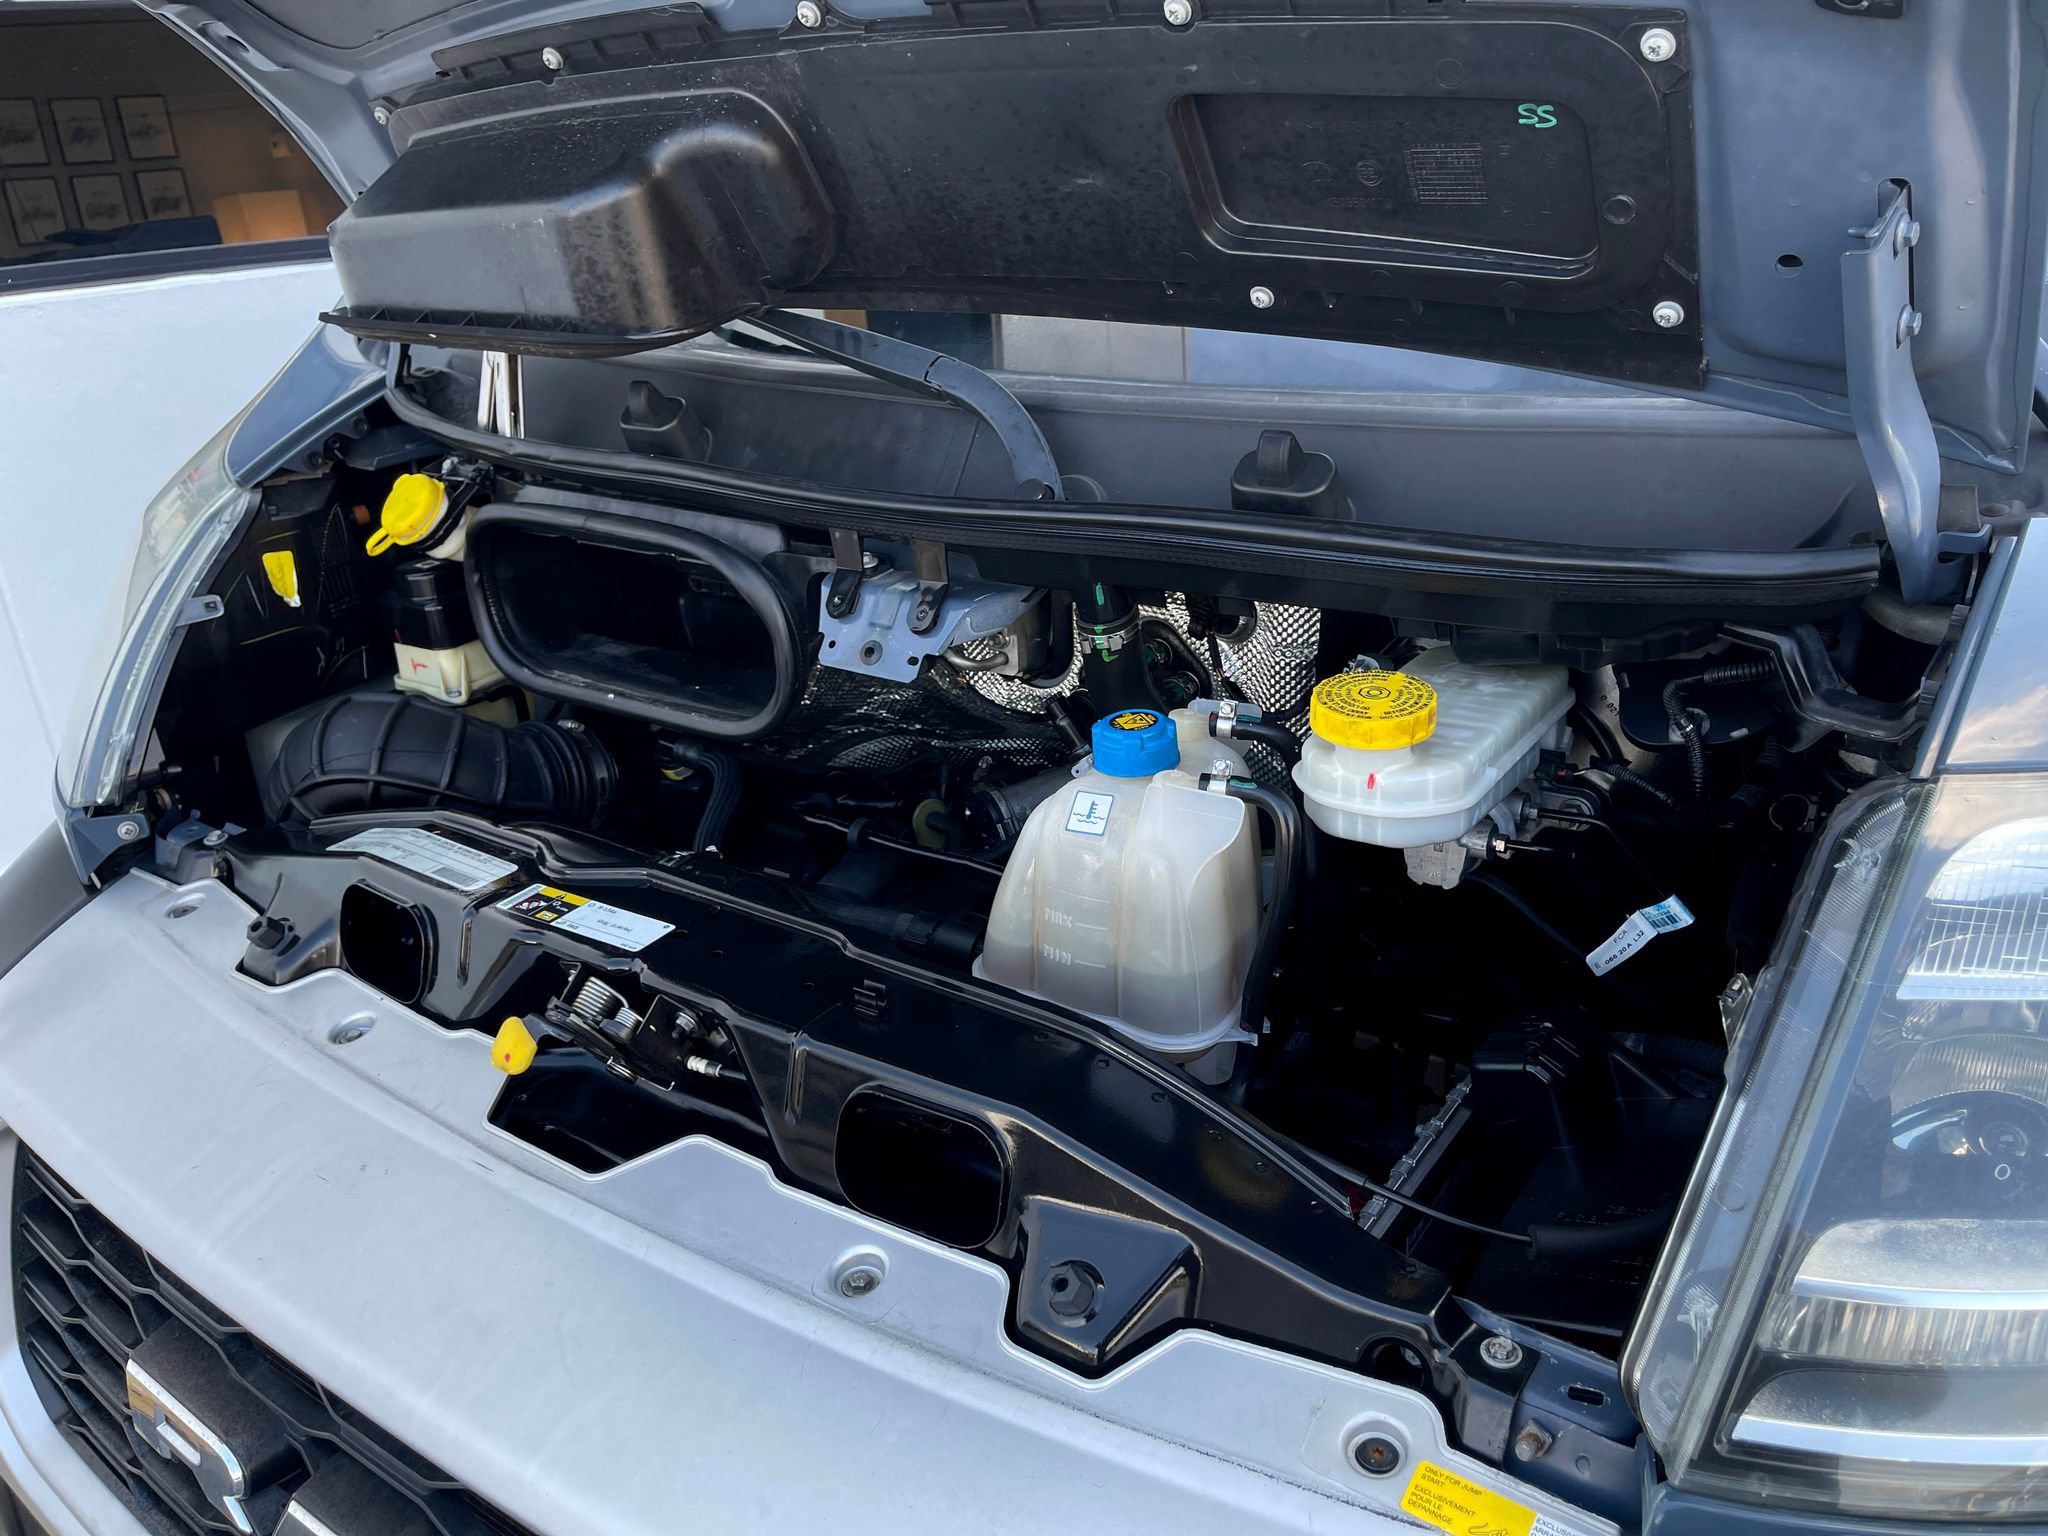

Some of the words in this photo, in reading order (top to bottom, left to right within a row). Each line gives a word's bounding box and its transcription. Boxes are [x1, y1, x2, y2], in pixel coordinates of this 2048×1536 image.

[1613, 929, 1628, 943] FCA
[1604, 954, 1618, 965] 066
[1421, 1473, 1446, 1488] START
[1424, 1466, 1446, 1478] ONLY
[1445, 1475, 1461, 1487] FOR
[1461, 1484, 1483, 1496] JUMP
[1411, 1491, 1433, 1506] POUR
[1414, 1484, 1477, 1517] EXCLUSIVEMENT
[1433, 1501, 1444, 1511] LE
[1407, 1498, 1454, 1525] DEPANNAGE
